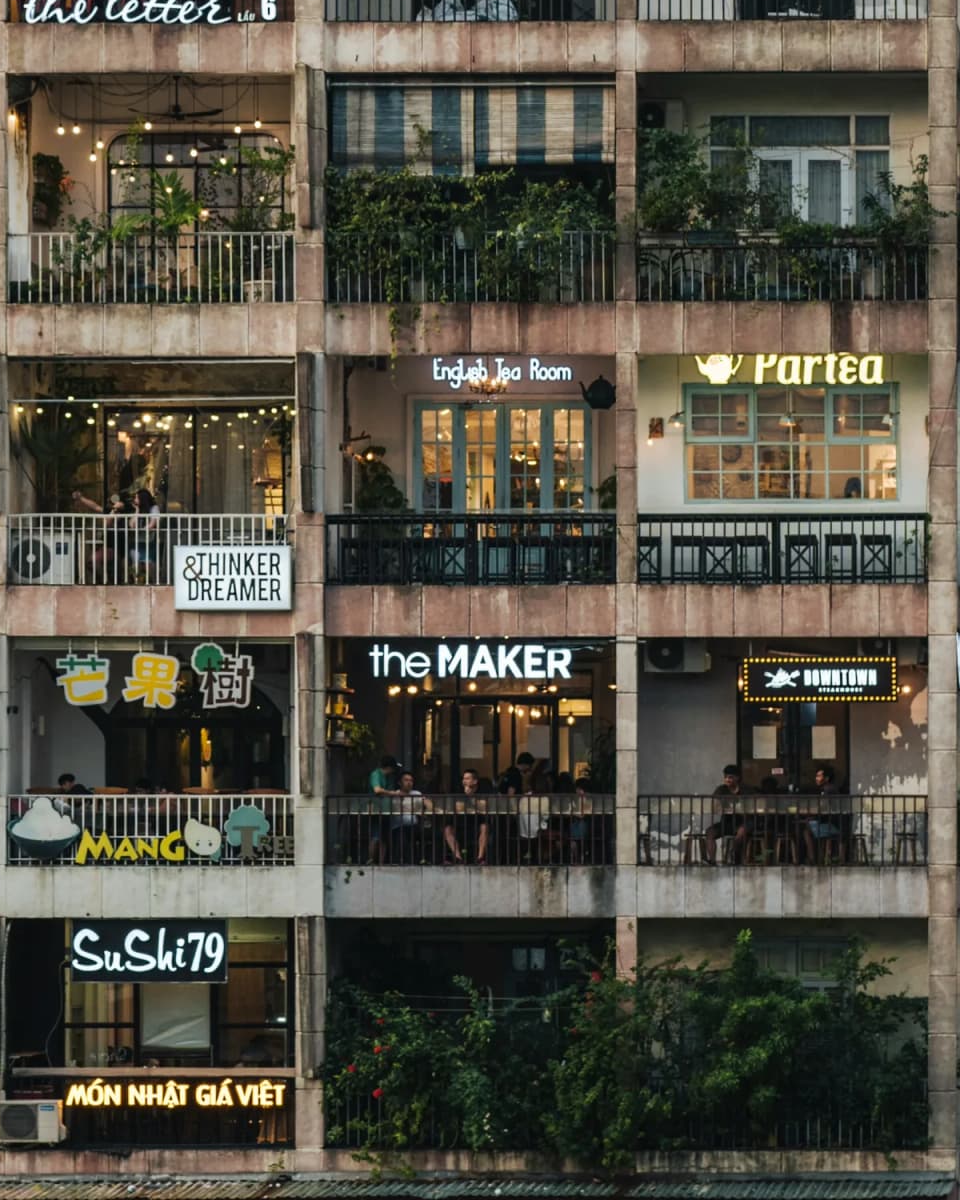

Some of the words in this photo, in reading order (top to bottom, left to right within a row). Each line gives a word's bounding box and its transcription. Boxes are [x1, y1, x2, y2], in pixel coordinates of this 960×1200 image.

[495, 358, 522, 381] Tea
[529, 358, 572, 380] Room
[196, 552, 281, 576] THINKER
[188, 578, 281, 601] DREAMER
[369, 644, 431, 678] the
[438, 644, 572, 678] MAKER
[803, 669, 877, 686] DOWNTOWN
[66, 1079, 121, 1106] MÓN
[128, 1080, 189, 1108] NHẬT
[195, 1079, 233, 1106] GIÁ
